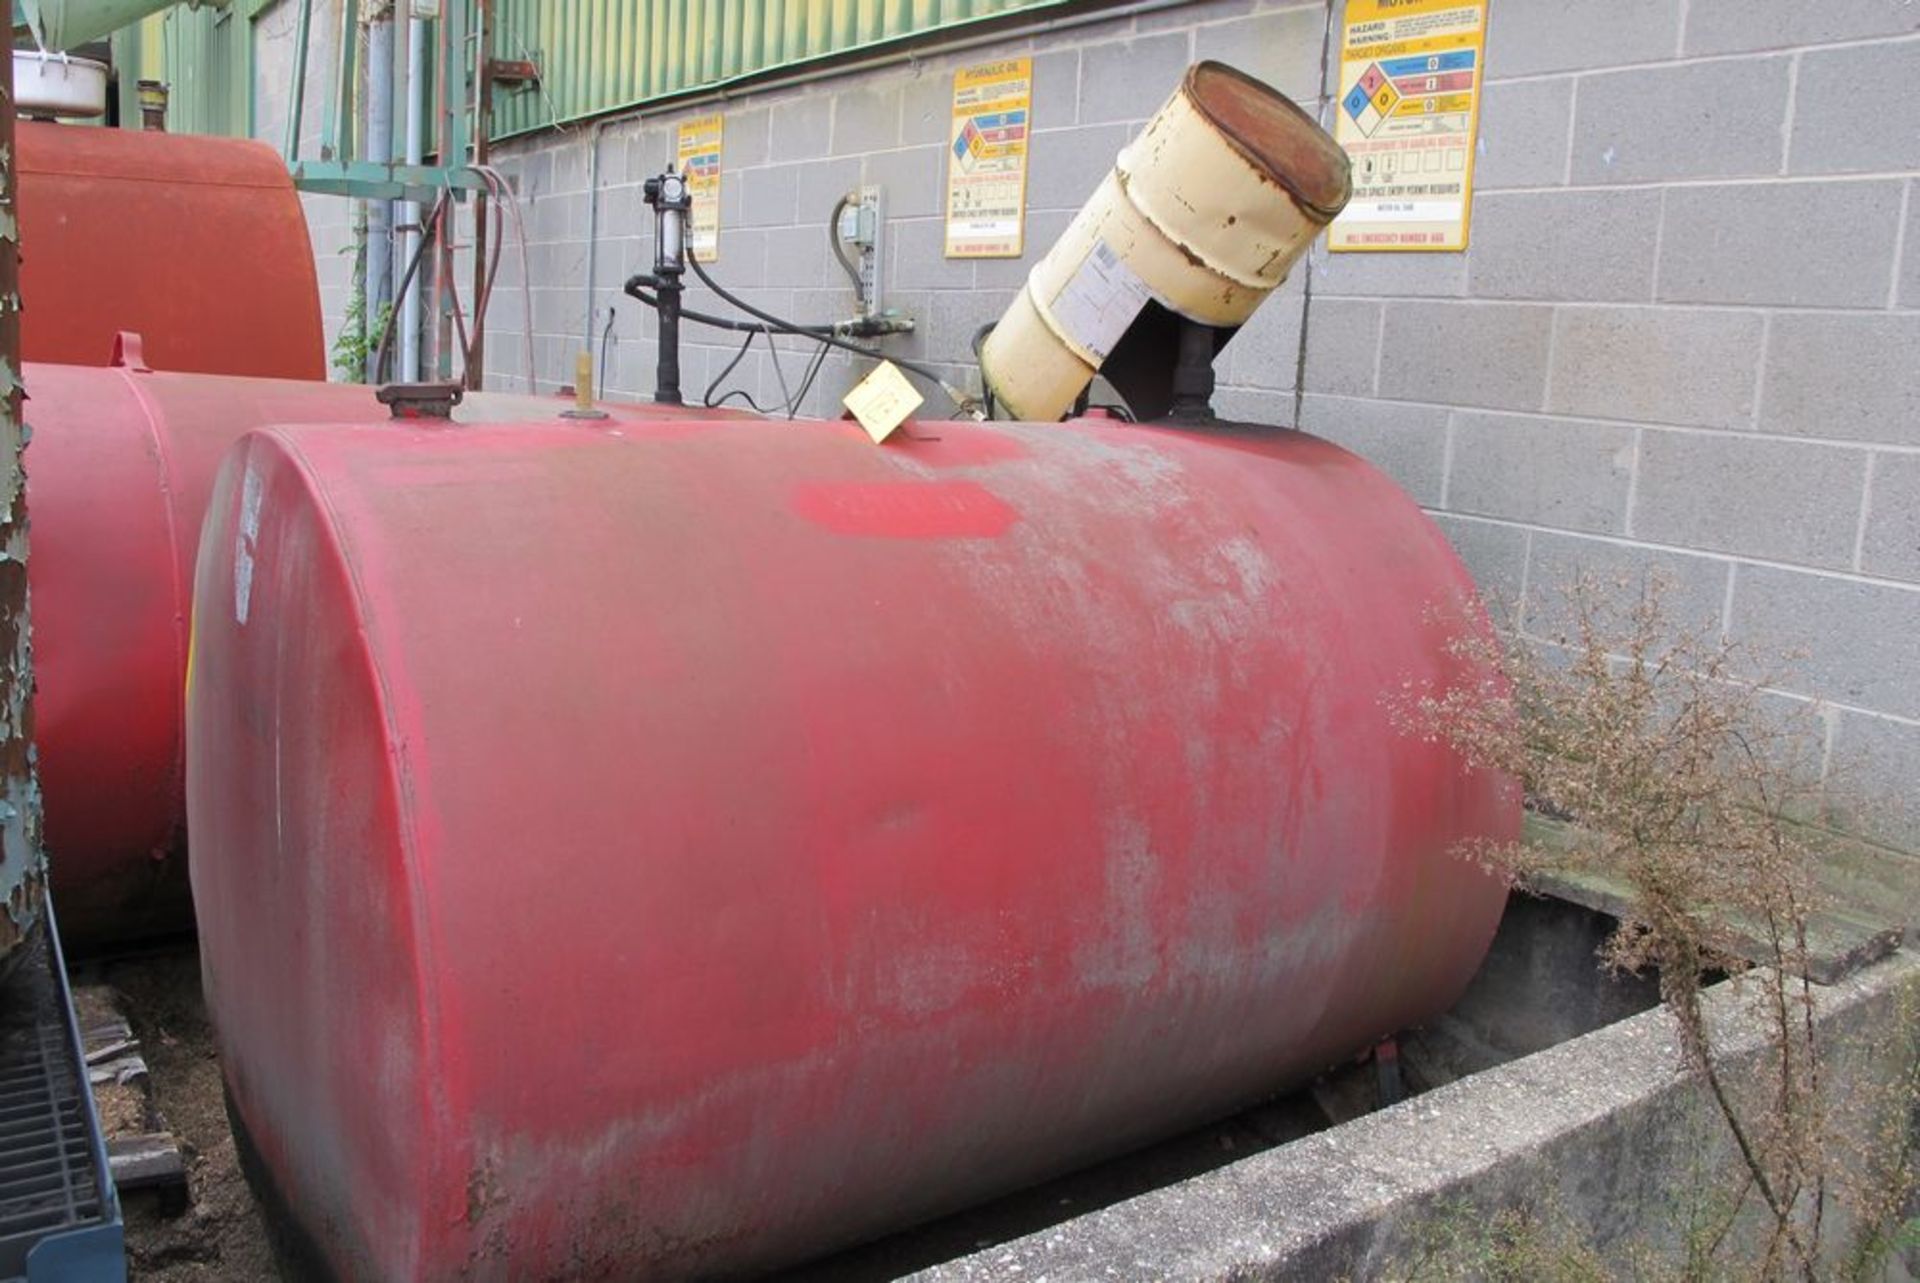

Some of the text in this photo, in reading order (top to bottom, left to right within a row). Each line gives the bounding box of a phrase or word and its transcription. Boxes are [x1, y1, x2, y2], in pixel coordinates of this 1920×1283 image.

[1349, 22, 1386, 33] HAZARD
[1352, 97, 1360, 108] 0
[1380, 94, 1389, 106] 0
